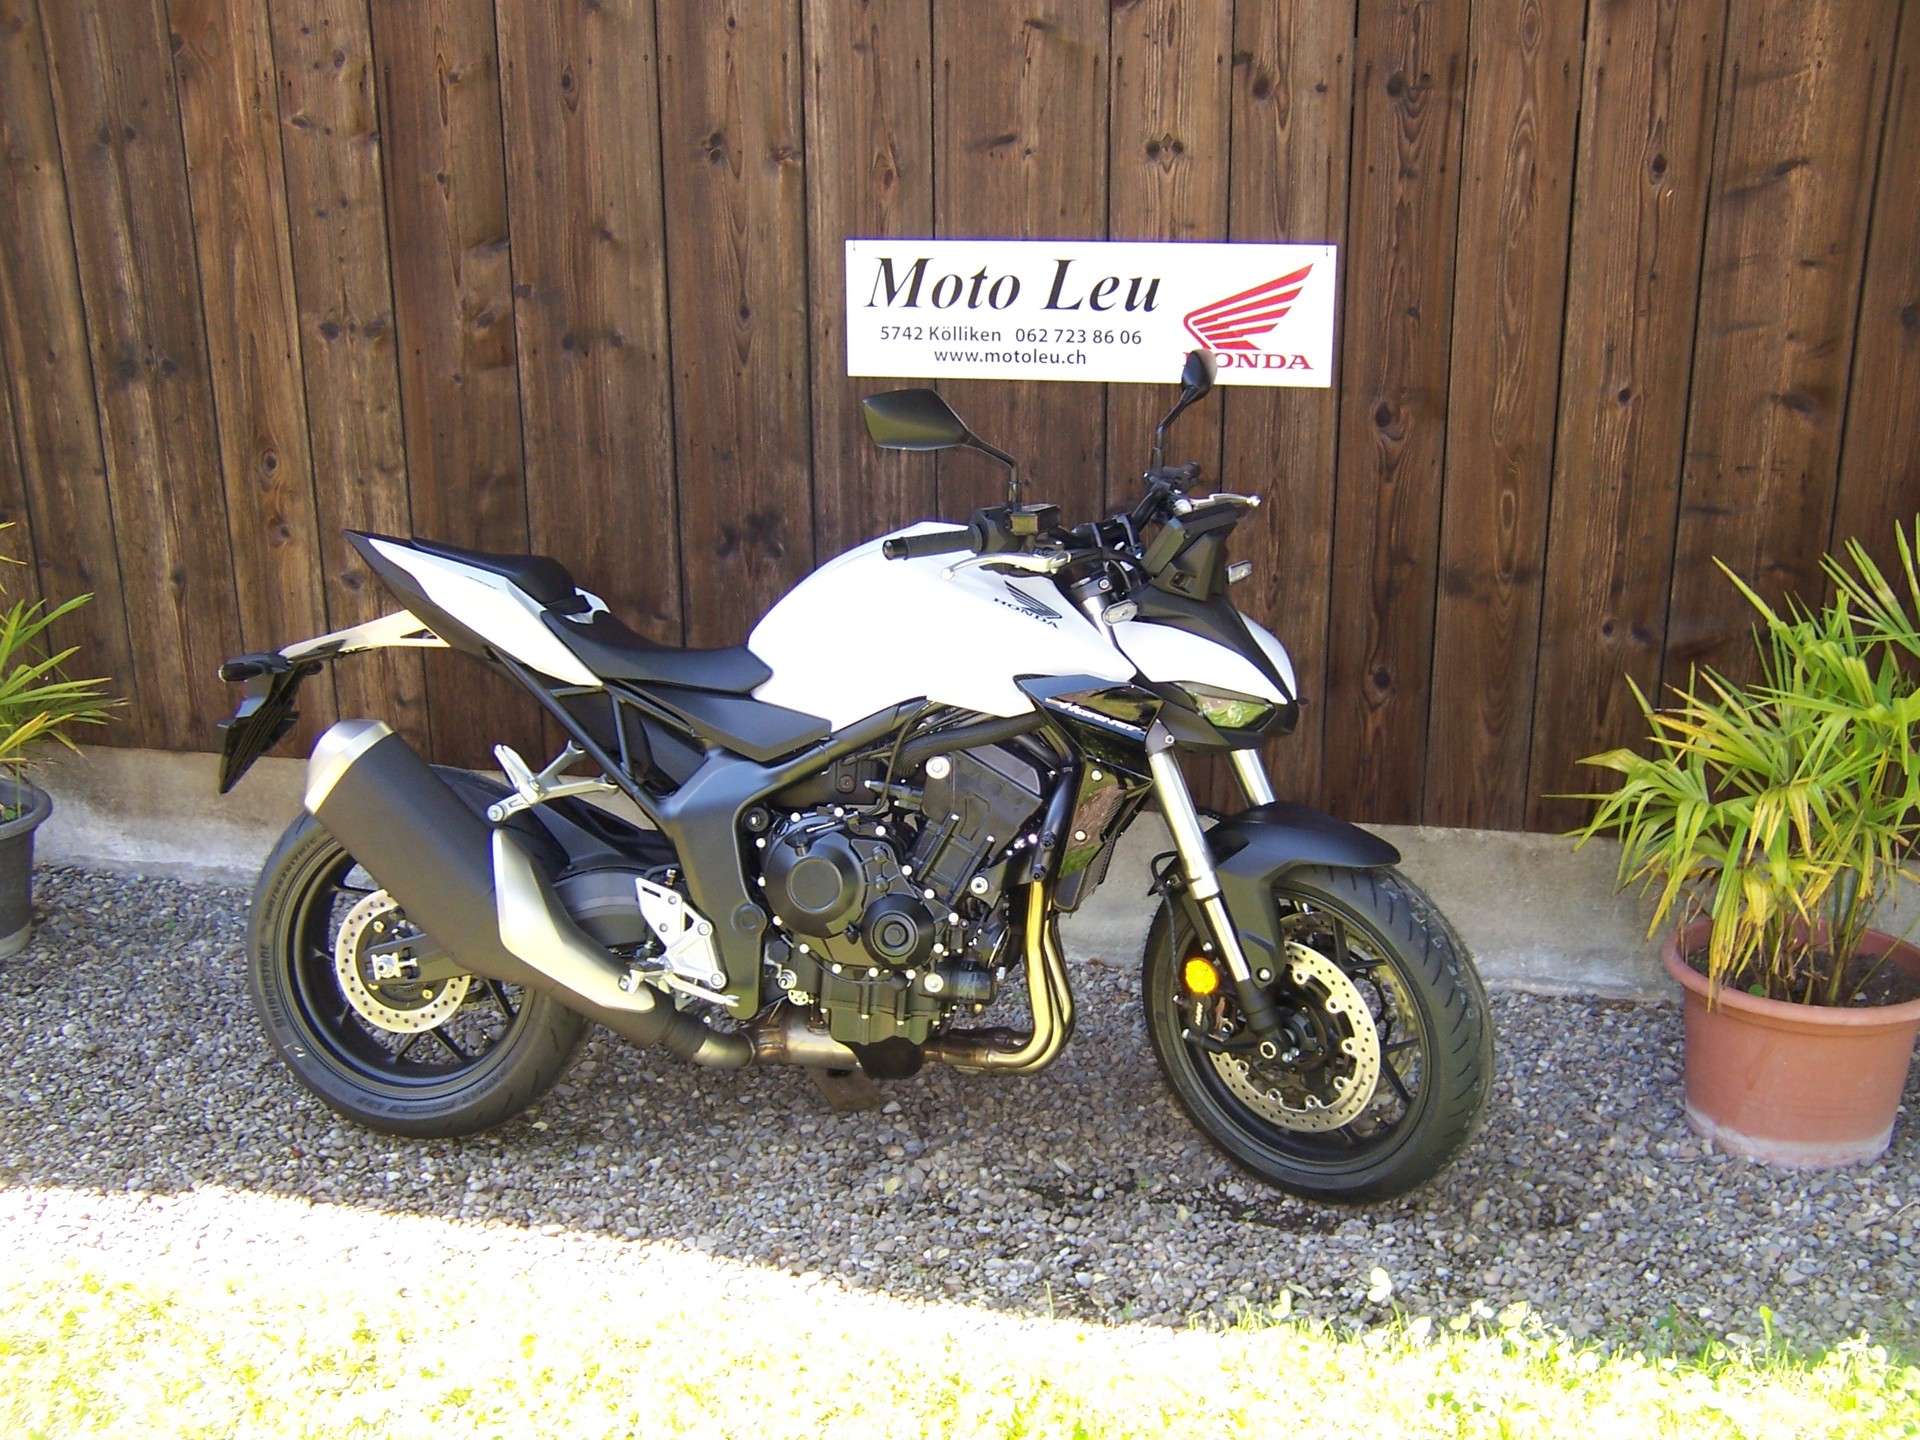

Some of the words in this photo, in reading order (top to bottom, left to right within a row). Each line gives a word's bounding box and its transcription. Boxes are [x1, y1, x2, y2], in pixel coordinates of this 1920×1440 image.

[865, 257, 1021, 310] Moto
[1040, 259, 1161, 313] Leu
[881, 326, 923, 340] 5742
[929, 326, 1001, 342] Kölliken
[1015, 328, 1048, 343] 062
[1054, 329, 1086, 344] 723
[1092, 329, 1114, 344] 86
[1120, 330, 1142, 345] 06
[934, 348, 1086, 365] www.motoleu.ch
[1183, 351, 1314, 370] ONDA
[993, 597, 1059, 629] HONDA
